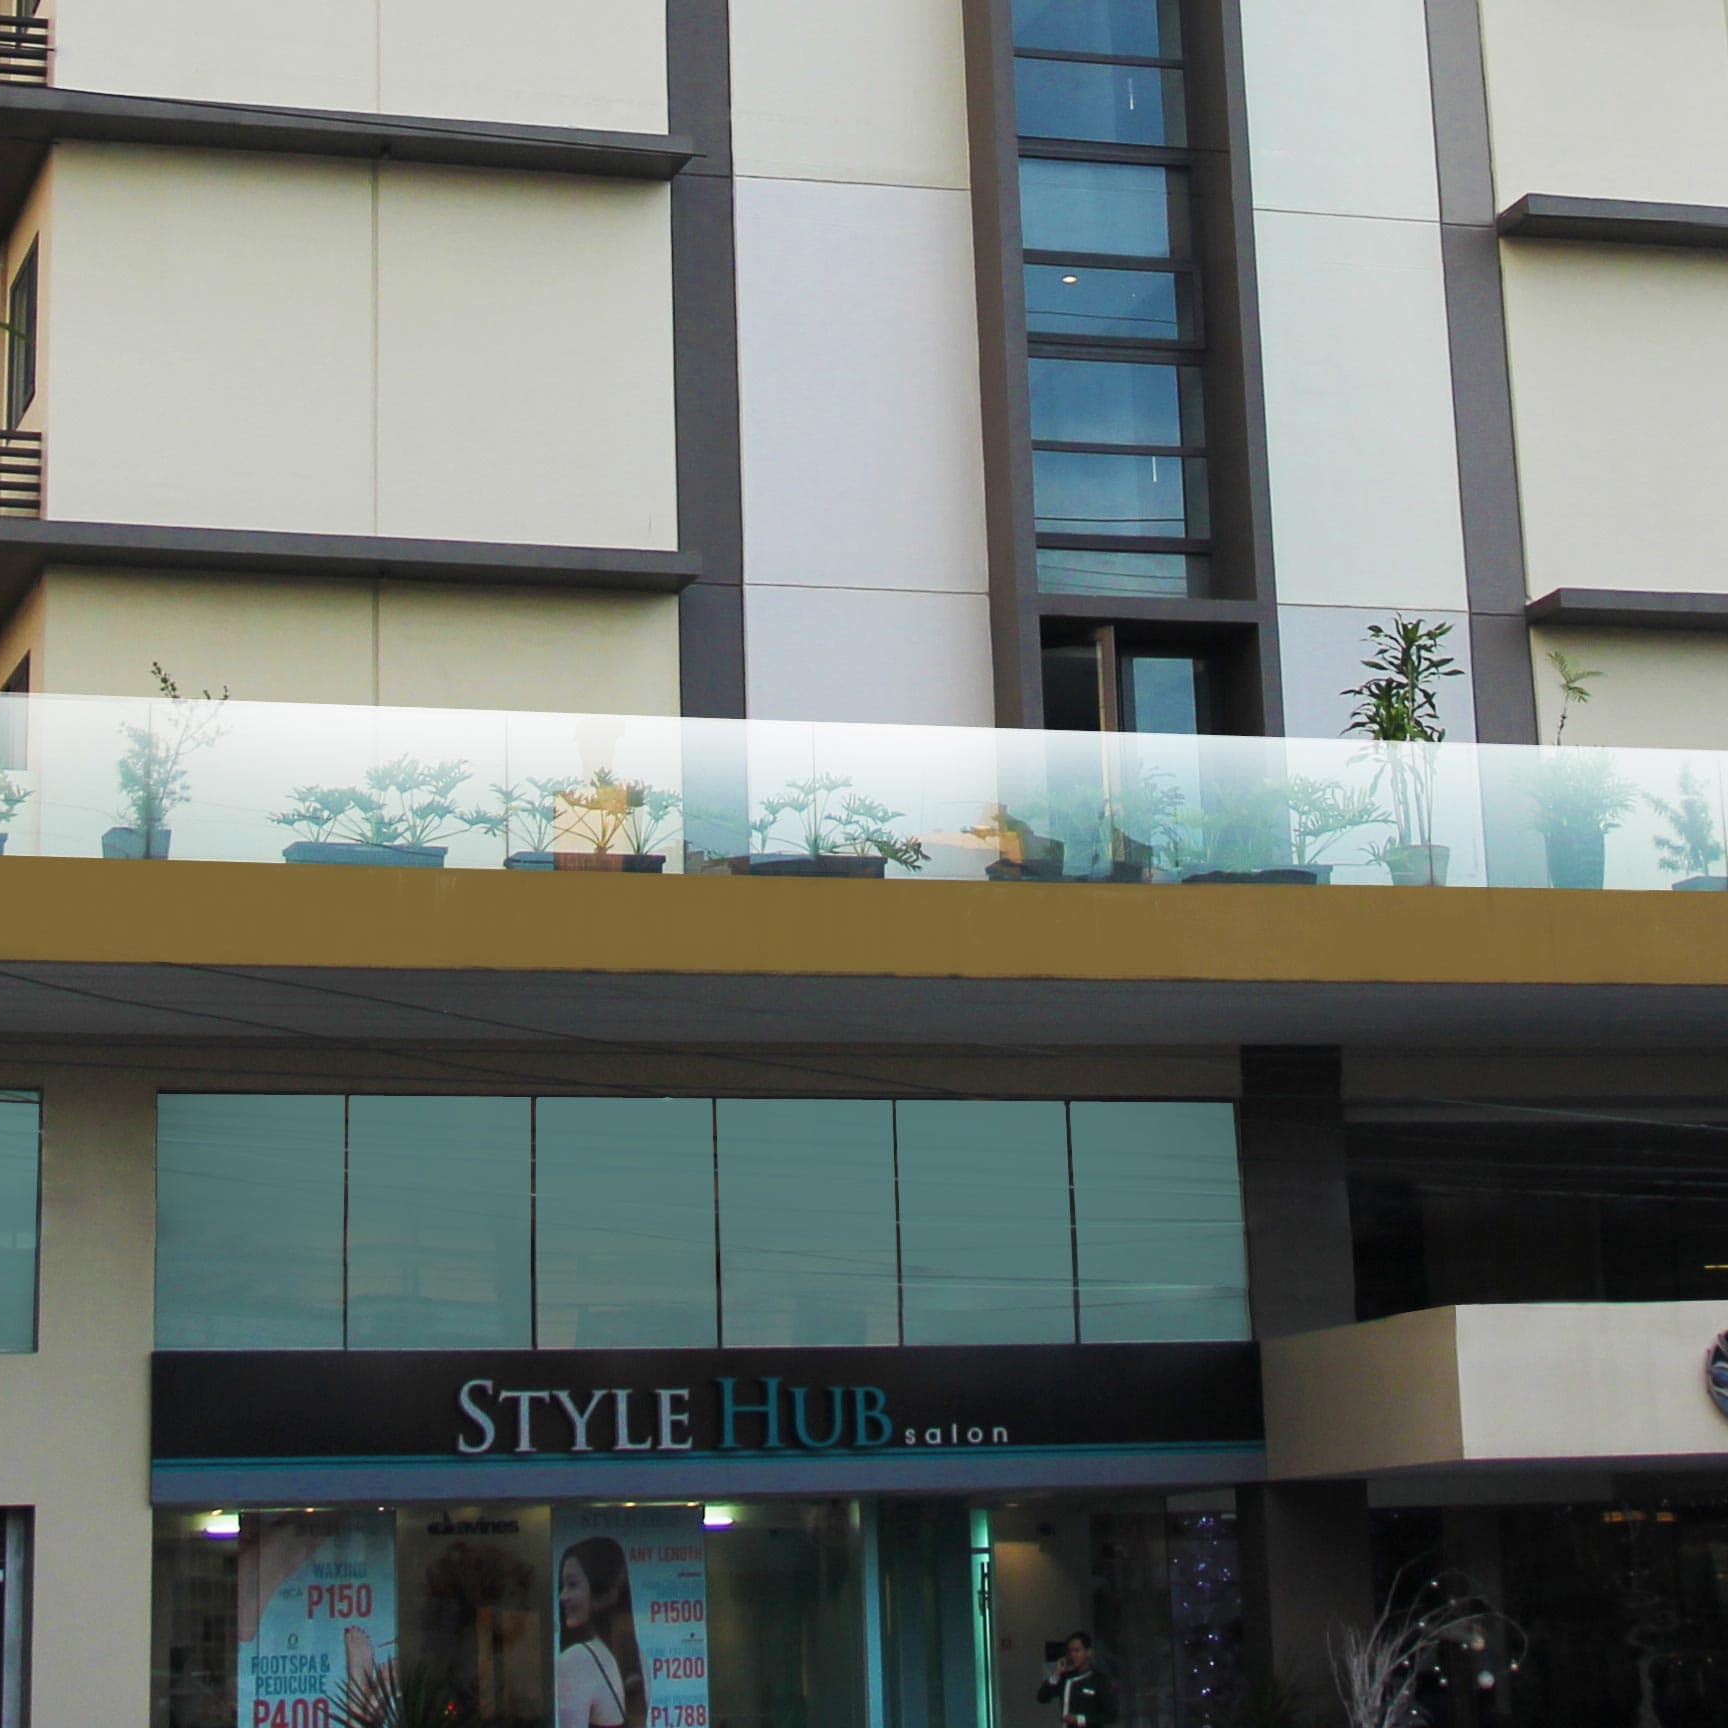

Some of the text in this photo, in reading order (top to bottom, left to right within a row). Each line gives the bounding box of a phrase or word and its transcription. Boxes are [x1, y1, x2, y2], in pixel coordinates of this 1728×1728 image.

[456, 1376, 1010, 1454] STYLE HUB salon
[306, 1583, 373, 1619] P150
[650, 1599, 705, 1623] P1500
[652, 1656, 706, 1680] P1200
[255, 1674, 328, 1696] PEDICURE
